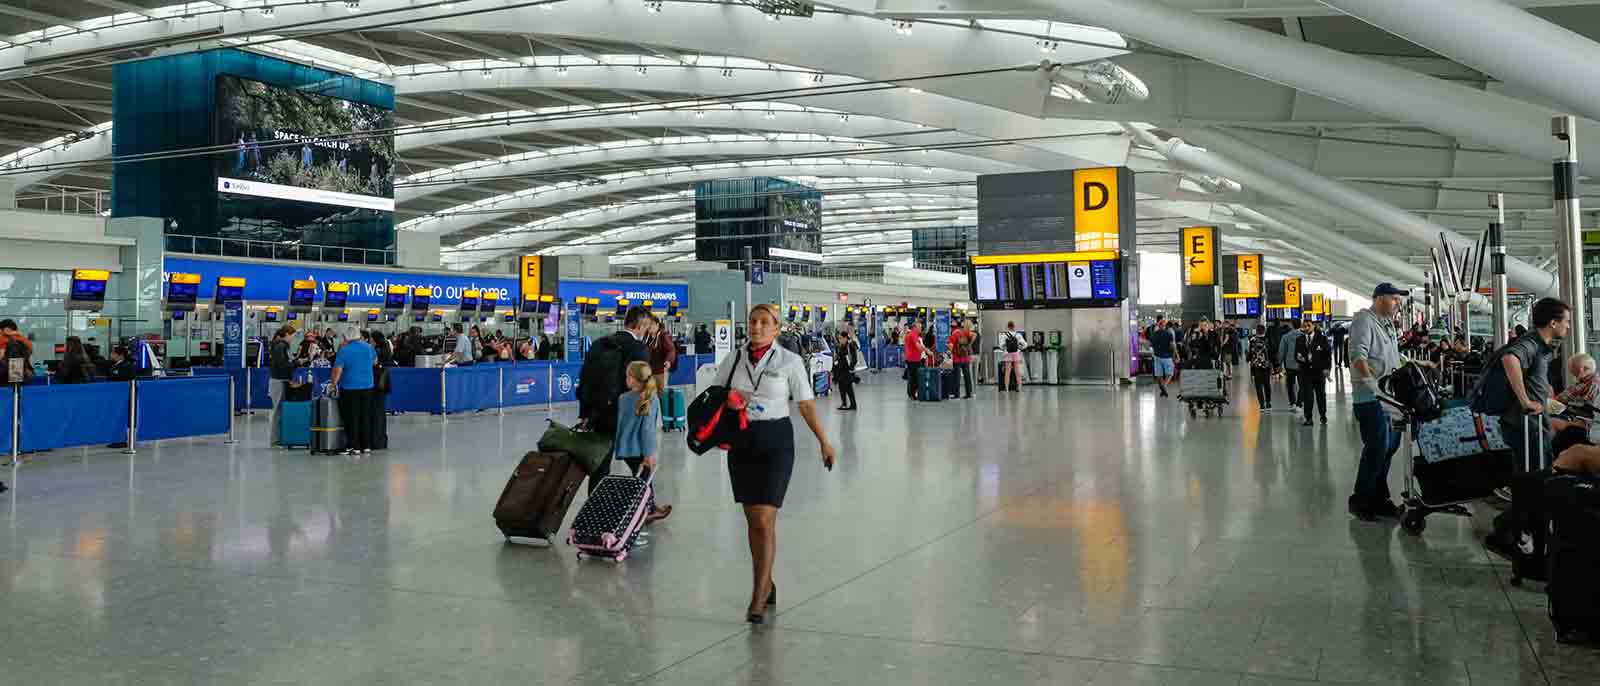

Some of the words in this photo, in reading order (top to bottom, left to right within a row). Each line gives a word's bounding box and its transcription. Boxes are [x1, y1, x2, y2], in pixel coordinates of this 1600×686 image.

[313, 137, 337, 149] CATCH
[339, 141, 351, 151] UP.
[1083, 182, 1109, 211] D
[1192, 235, 1204, 254] E
[527, 262, 536, 277] E
[1243, 261, 1253, 271] F
[322, 281, 360, 296] wm
[364, 279, 424, 297] welm
[428, 283, 442, 299] to
[1287, 282, 1297, 293] G
[625, 291, 651, 300] BRITISH
[651, 292, 677, 301] AIRWAYS
